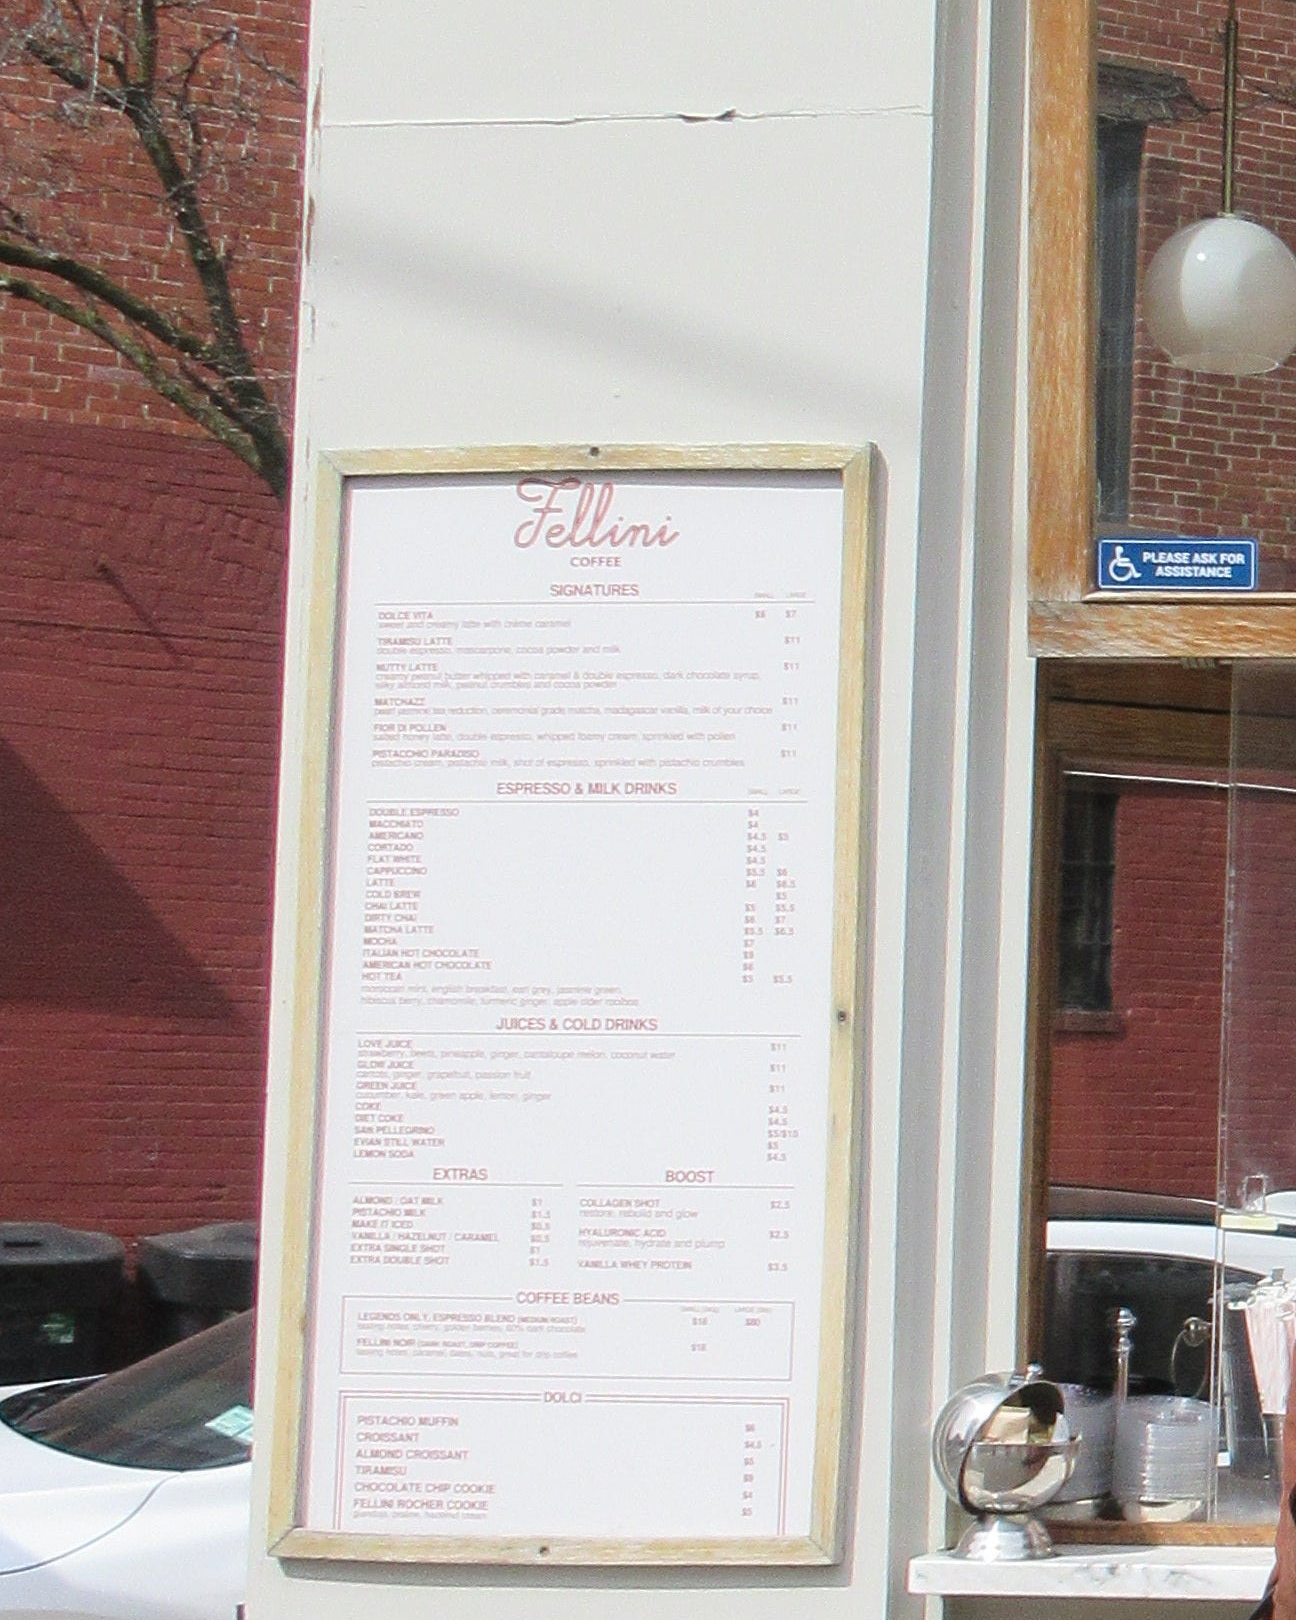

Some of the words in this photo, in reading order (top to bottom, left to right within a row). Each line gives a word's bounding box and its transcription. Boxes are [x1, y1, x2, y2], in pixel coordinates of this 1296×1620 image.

[513, 477, 681, 548] Fellini
[570, 556, 622, 568] COFFEE
[1142, 551, 1190, 564] PLEASE
[1192, 552, 1218, 565] ASK
[1219, 553, 1245, 565] FOR
[1155, 566, 1232, 578] ASSISTANCE
[550, 584, 639, 596] SIGNATURES
[414, 611, 433, 619] VITA
[377, 637, 421, 645] TIRAMISU
[424, 637, 452, 645] LATTE
[376, 663, 406, 671] NUTTY
[409, 663, 437, 671] LATTE
[497, 783, 571, 794] ESPRESSO
[575, 783, 583, 794] &
[588, 783, 621, 794] MILK
[624, 783, 677, 794] DRINKS
[369, 808, 406, 816] DOUBLE
[410, 808, 459, 816] ESPRESSO
[367, 843, 413, 851] CORTADO
[367, 855, 390, 863] FLAT
[393, 855, 421, 863] WHITE
[364, 925, 402, 933] MATCHA
[363, 949, 398, 957] ITALIAN
[401, 949, 419, 957] HOT
[422, 949, 479, 957] CHOCOLATE
[362, 961, 411, 969] AMERICAN
[413, 961, 431, 969] HOT
[434, 961, 492, 969] CHOCOLATE
[361, 972, 380, 980] HOT
[384, 972, 402, 980] TEA
[496, 1018, 545, 1030] JUICES
[549, 1018, 558, 1030] &
[563, 1018, 601, 1030] COLD
[605, 1018, 657, 1030] DRINKS
[385, 1040, 412, 1048] JUICE
[357, 1081, 387, 1089] GREEN
[390, 1081, 416, 1089] JUICE
[355, 1114, 376, 1122] DIET
[378, 1114, 403, 1122] COKE
[354, 1126, 373, 1134] SAN
[376, 1126, 434, 1134] PELLEGRINO
[354, 1137, 381, 1146] EVIAN
[383, 1138, 409, 1146] STILL
[412, 1138, 445, 1146] WATER
[353, 1149, 386, 1157] LEMON
[388, 1150, 414, 1158] SODA
[433, 1168, 488, 1180] EXTRAS
[665, 1170, 715, 1182] BOOST
[353, 1195, 392, 1204] ALMOND
[400, 1196, 418, 1204] OAT
[421, 1196, 443, 1205] MILK
[580, 1198, 632, 1207] COLLAGEN
[635, 1199, 660, 1207] SHOT
[352, 1208, 401, 1216] PISTACHIO
[404, 1208, 426, 1216] MILK
[351, 1232, 390, 1240] VANILLA
[398, 1232, 446, 1241] HAZELNUT
[579, 1228, 641, 1237] HYALURONIC
[643, 1229, 666, 1237] ACID
[350, 1243, 381, 1252] EXTRA
[384, 1244, 417, 1252] SINGLE
[419, 1244, 445, 1252] SHOT
[350, 1255, 381, 1264] EXTRA
[383, 1256, 421, 1264] DOUBLE
[426, 1256, 449, 1264] SHOT
[578, 1260, 618, 1268] VANILLA
[621, 1260, 647, 1269] WHEY
[650, 1260, 692, 1269] PROTEIN
[517, 1292, 569, 1304] COFFEE
[574, 1292, 619, 1304] BEANS
[358, 1312, 401, 1321] LEGENDS
[433, 1313, 481, 1322] ESPRESSO
[484, 1314, 515, 1323] BLEND
[357, 1338, 391, 1346] FELLINI
[544, 1391, 582, 1403] DOLCI
[357, 1416, 416, 1426] PISTACHIO
[419, 1417, 458, 1427] MUFFIN
[357, 1432, 420, 1442] CROISSANT
[356, 1449, 402, 1459] ALMOND
[406, 1449, 468, 1460] CROISSANT
[355, 1465, 407, 1475] TIRAMISU
[354, 1482, 422, 1493] CHOCOLATE
[425, 1483, 451, 1493] CHIP
[454, 1483, 495, 1494] COOKIE
[354, 1498, 393, 1509] FELLINI
[397, 1499, 444, 1510] ROCHER
[447, 1500, 488, 1510] COOKIE
